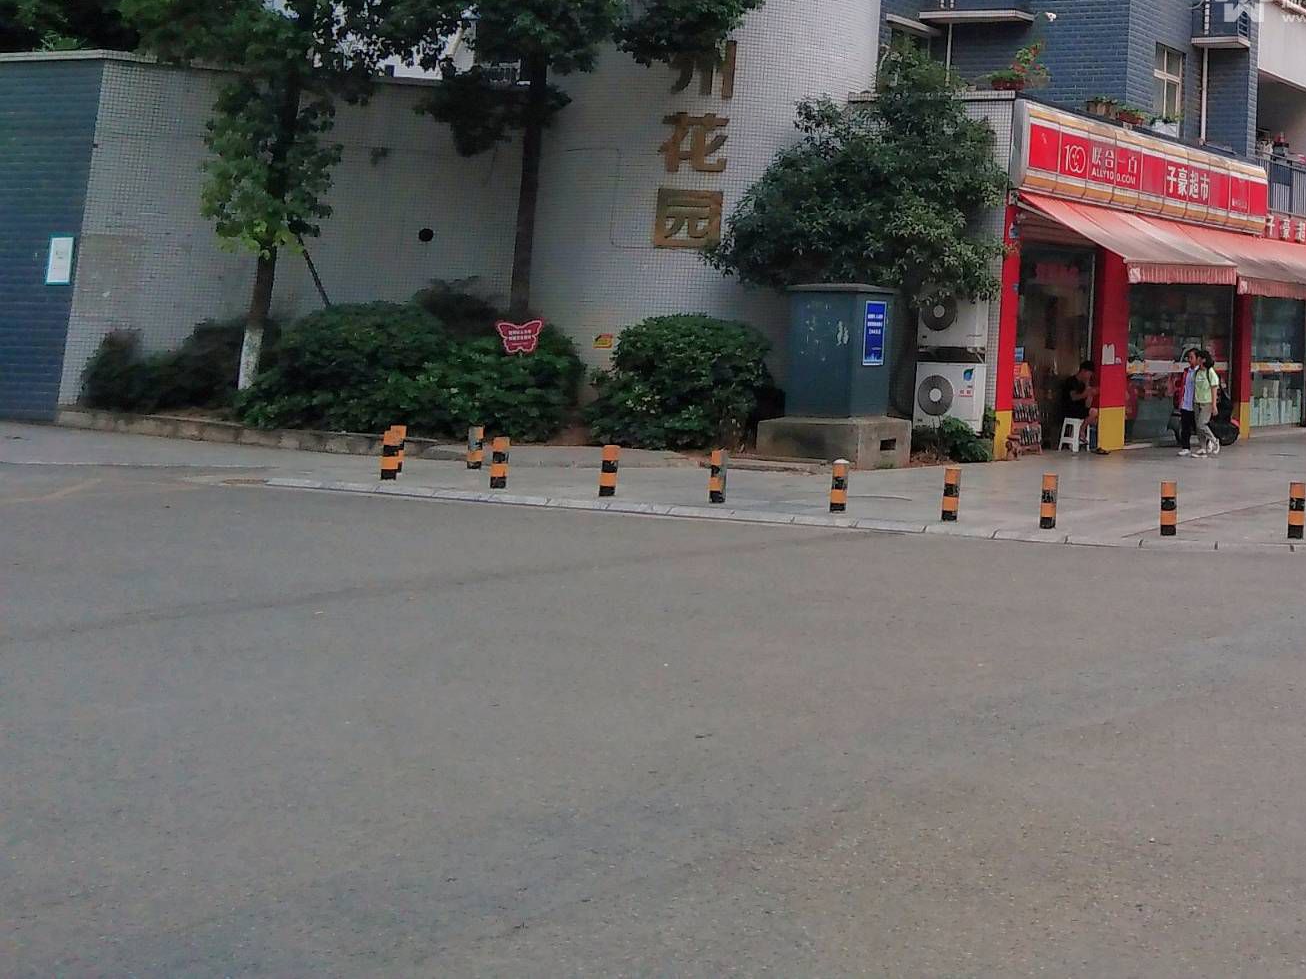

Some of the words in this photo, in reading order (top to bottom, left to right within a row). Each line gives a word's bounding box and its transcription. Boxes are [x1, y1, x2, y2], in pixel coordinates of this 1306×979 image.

[1091, 146, 1138, 173] 联合一百
[1166, 166, 1210, 201] 子豪超市
